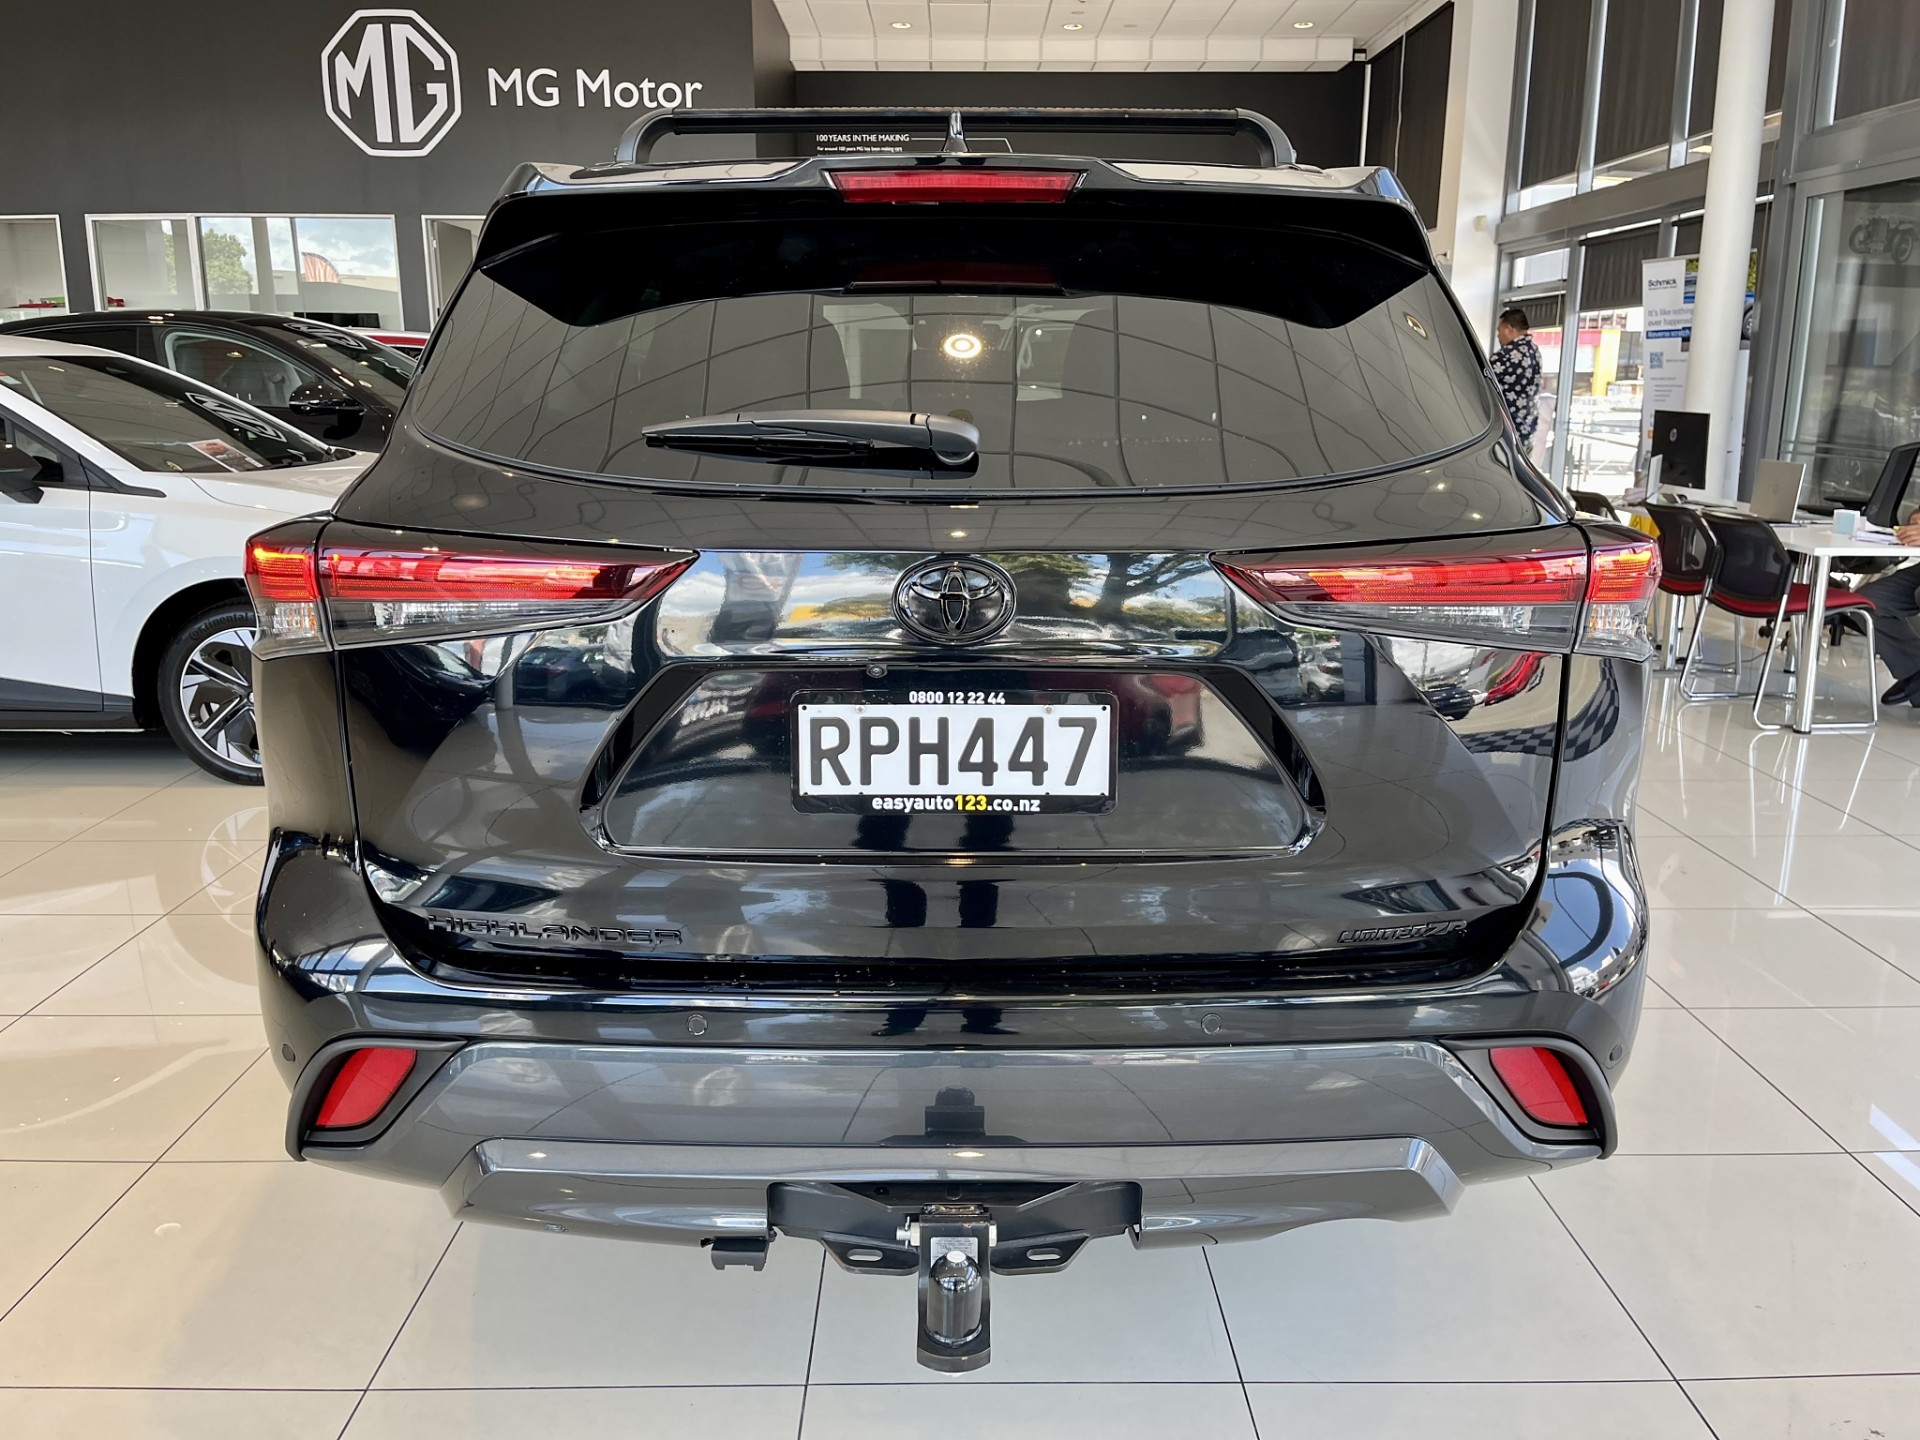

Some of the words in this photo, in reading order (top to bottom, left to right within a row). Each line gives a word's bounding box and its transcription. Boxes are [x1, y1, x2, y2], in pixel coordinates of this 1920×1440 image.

[331, 20, 452, 146] MG
[487, 67, 560, 107] MG
[576, 68, 704, 109] Motor
[815, 134, 828, 142] 100
[828, 134, 852, 142] YEARS
[852, 134, 861, 142] IN
[861, 134, 877, 142] THE
[878, 133, 910, 142] MAKING
[1647, 278, 1677, 288] Schmick
[908, 692, 943, 704] 0800
[947, 692, 964, 704] 12
[967, 692, 985, 704] 22
[987, 691, 1006, 704] 44
[809, 716, 1098, 786] RPH447
[871, 794, 1041, 814] easyauto123.co.nz
[427, 914, 683, 945] HIGHLANDER
